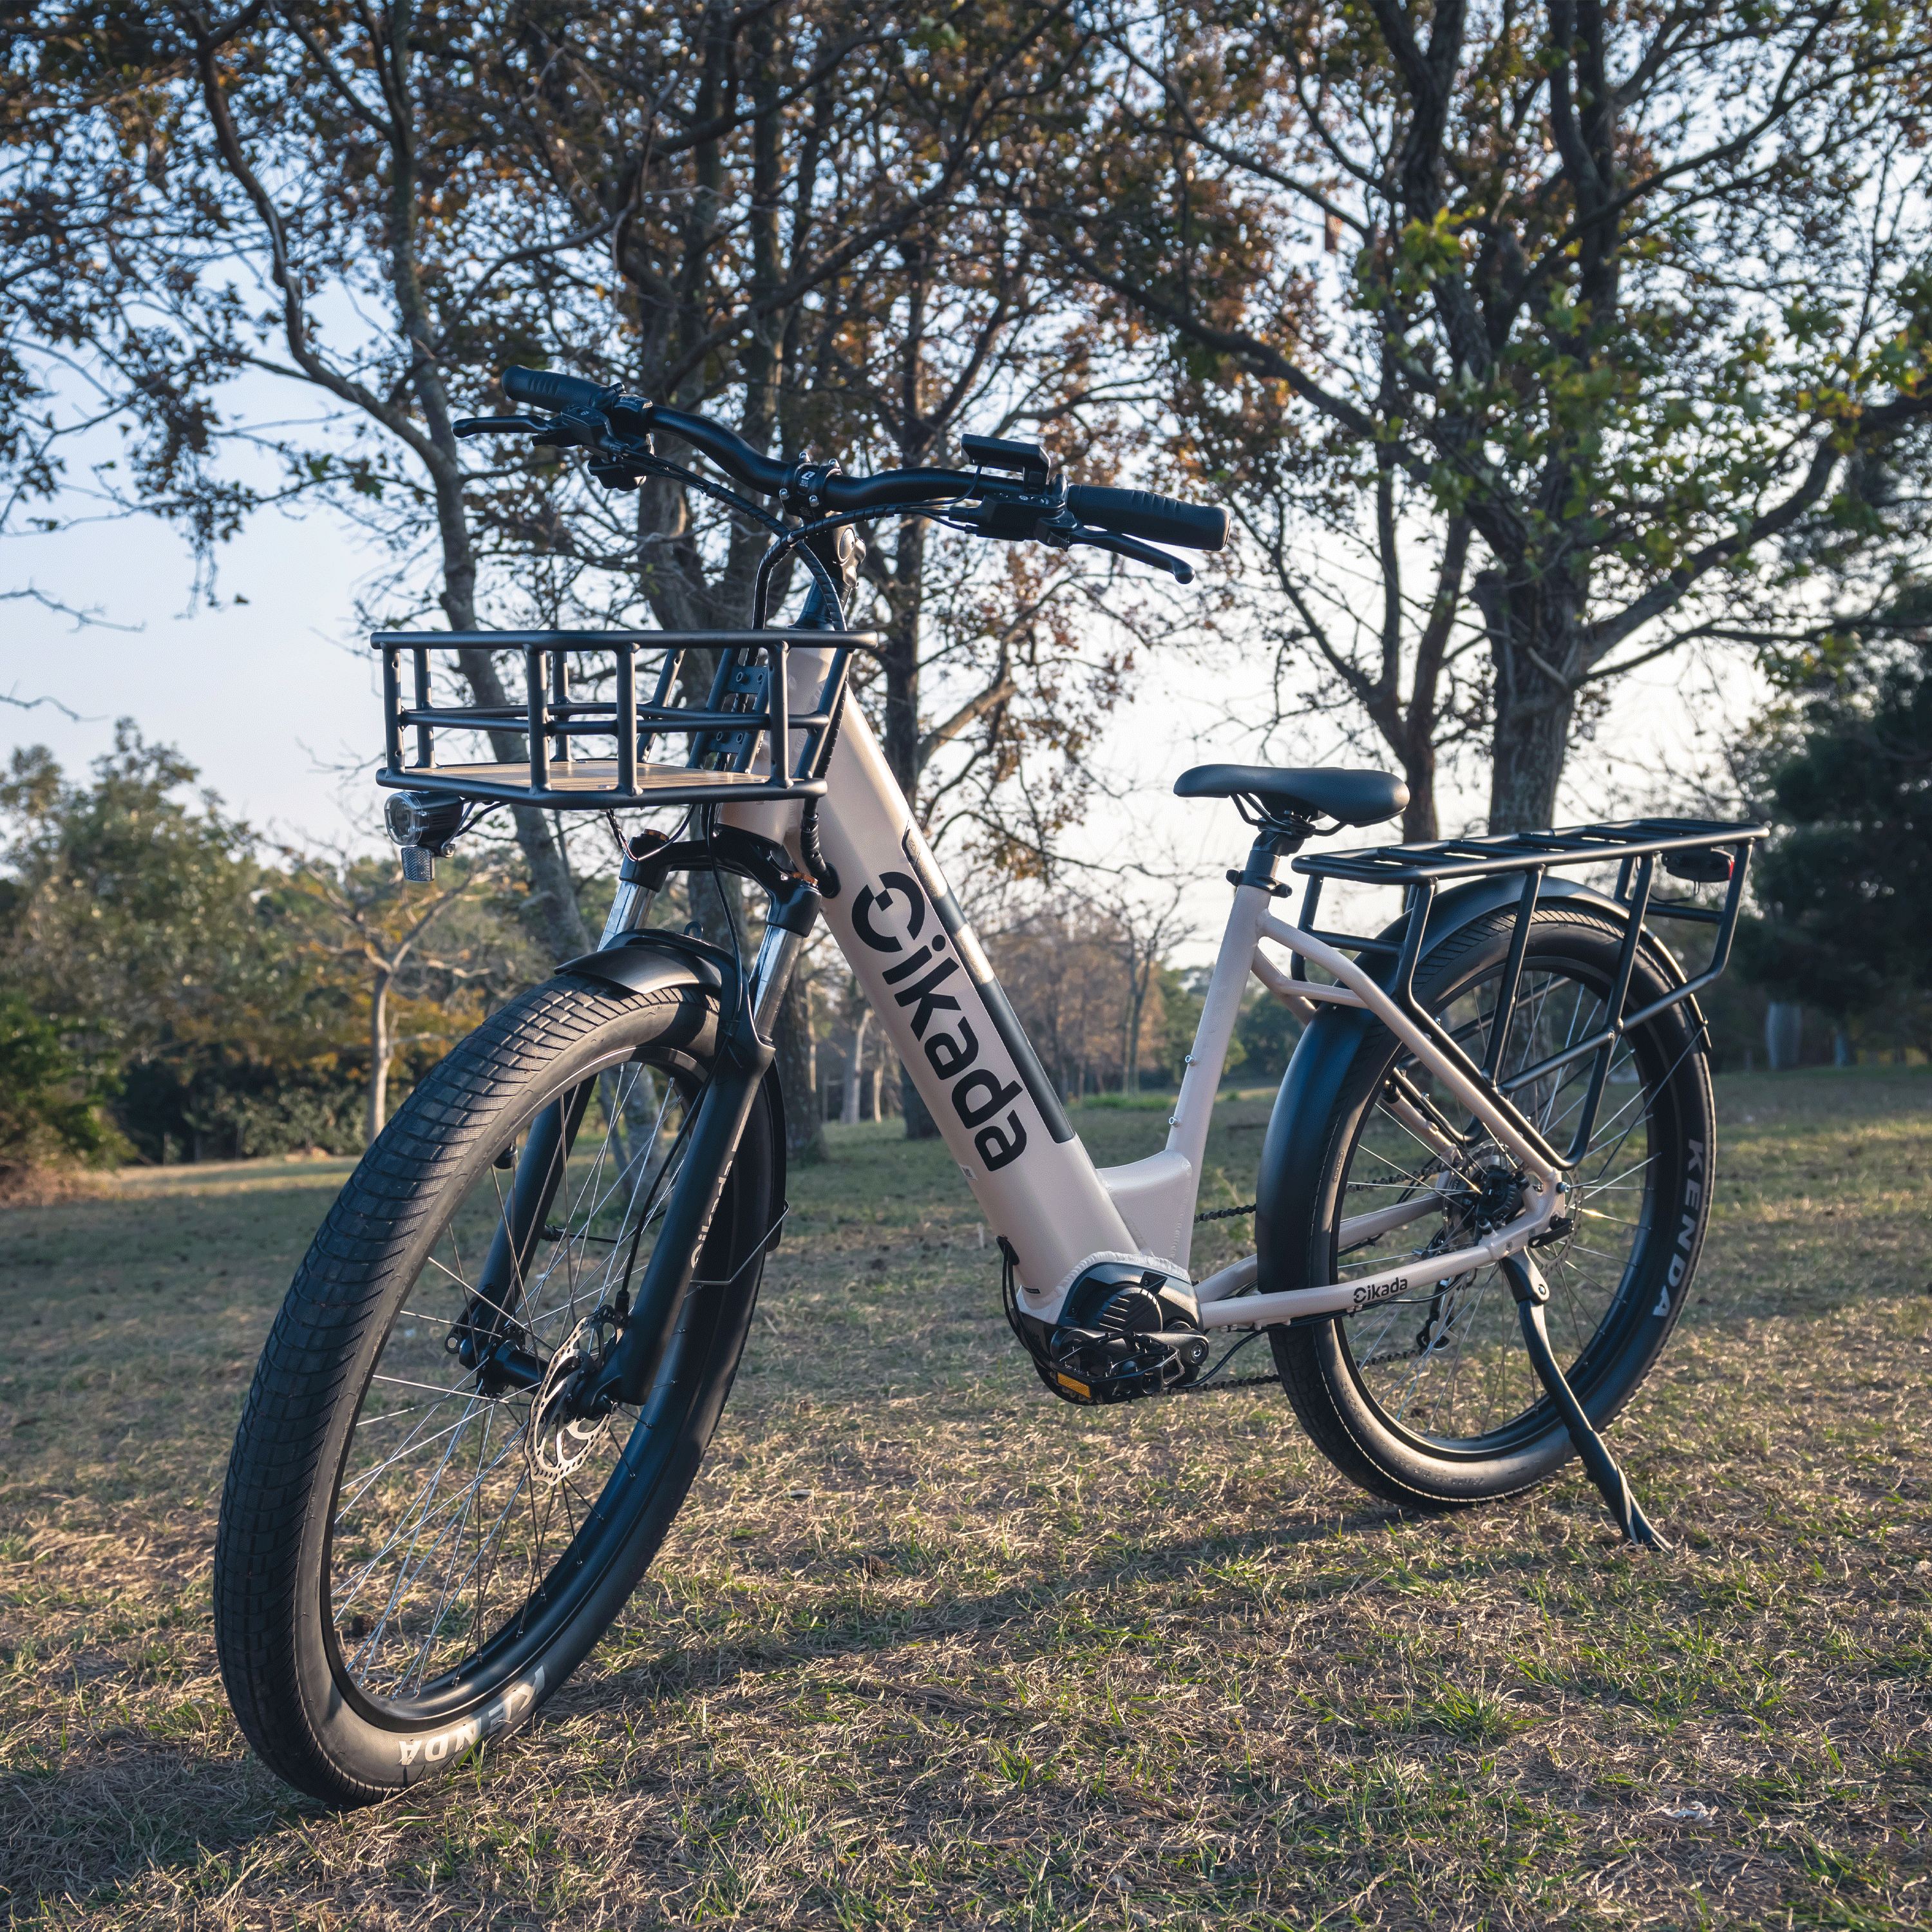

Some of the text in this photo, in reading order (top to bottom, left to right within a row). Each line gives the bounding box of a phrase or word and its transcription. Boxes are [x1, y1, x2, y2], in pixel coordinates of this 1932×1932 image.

[851, 871, 1027, 1171] Cikada
[1353, 1277, 1408, 1304] Cikada
[1653, 1139, 1705, 1317] KENDA
[398, 1665, 545, 1766] KENDA
